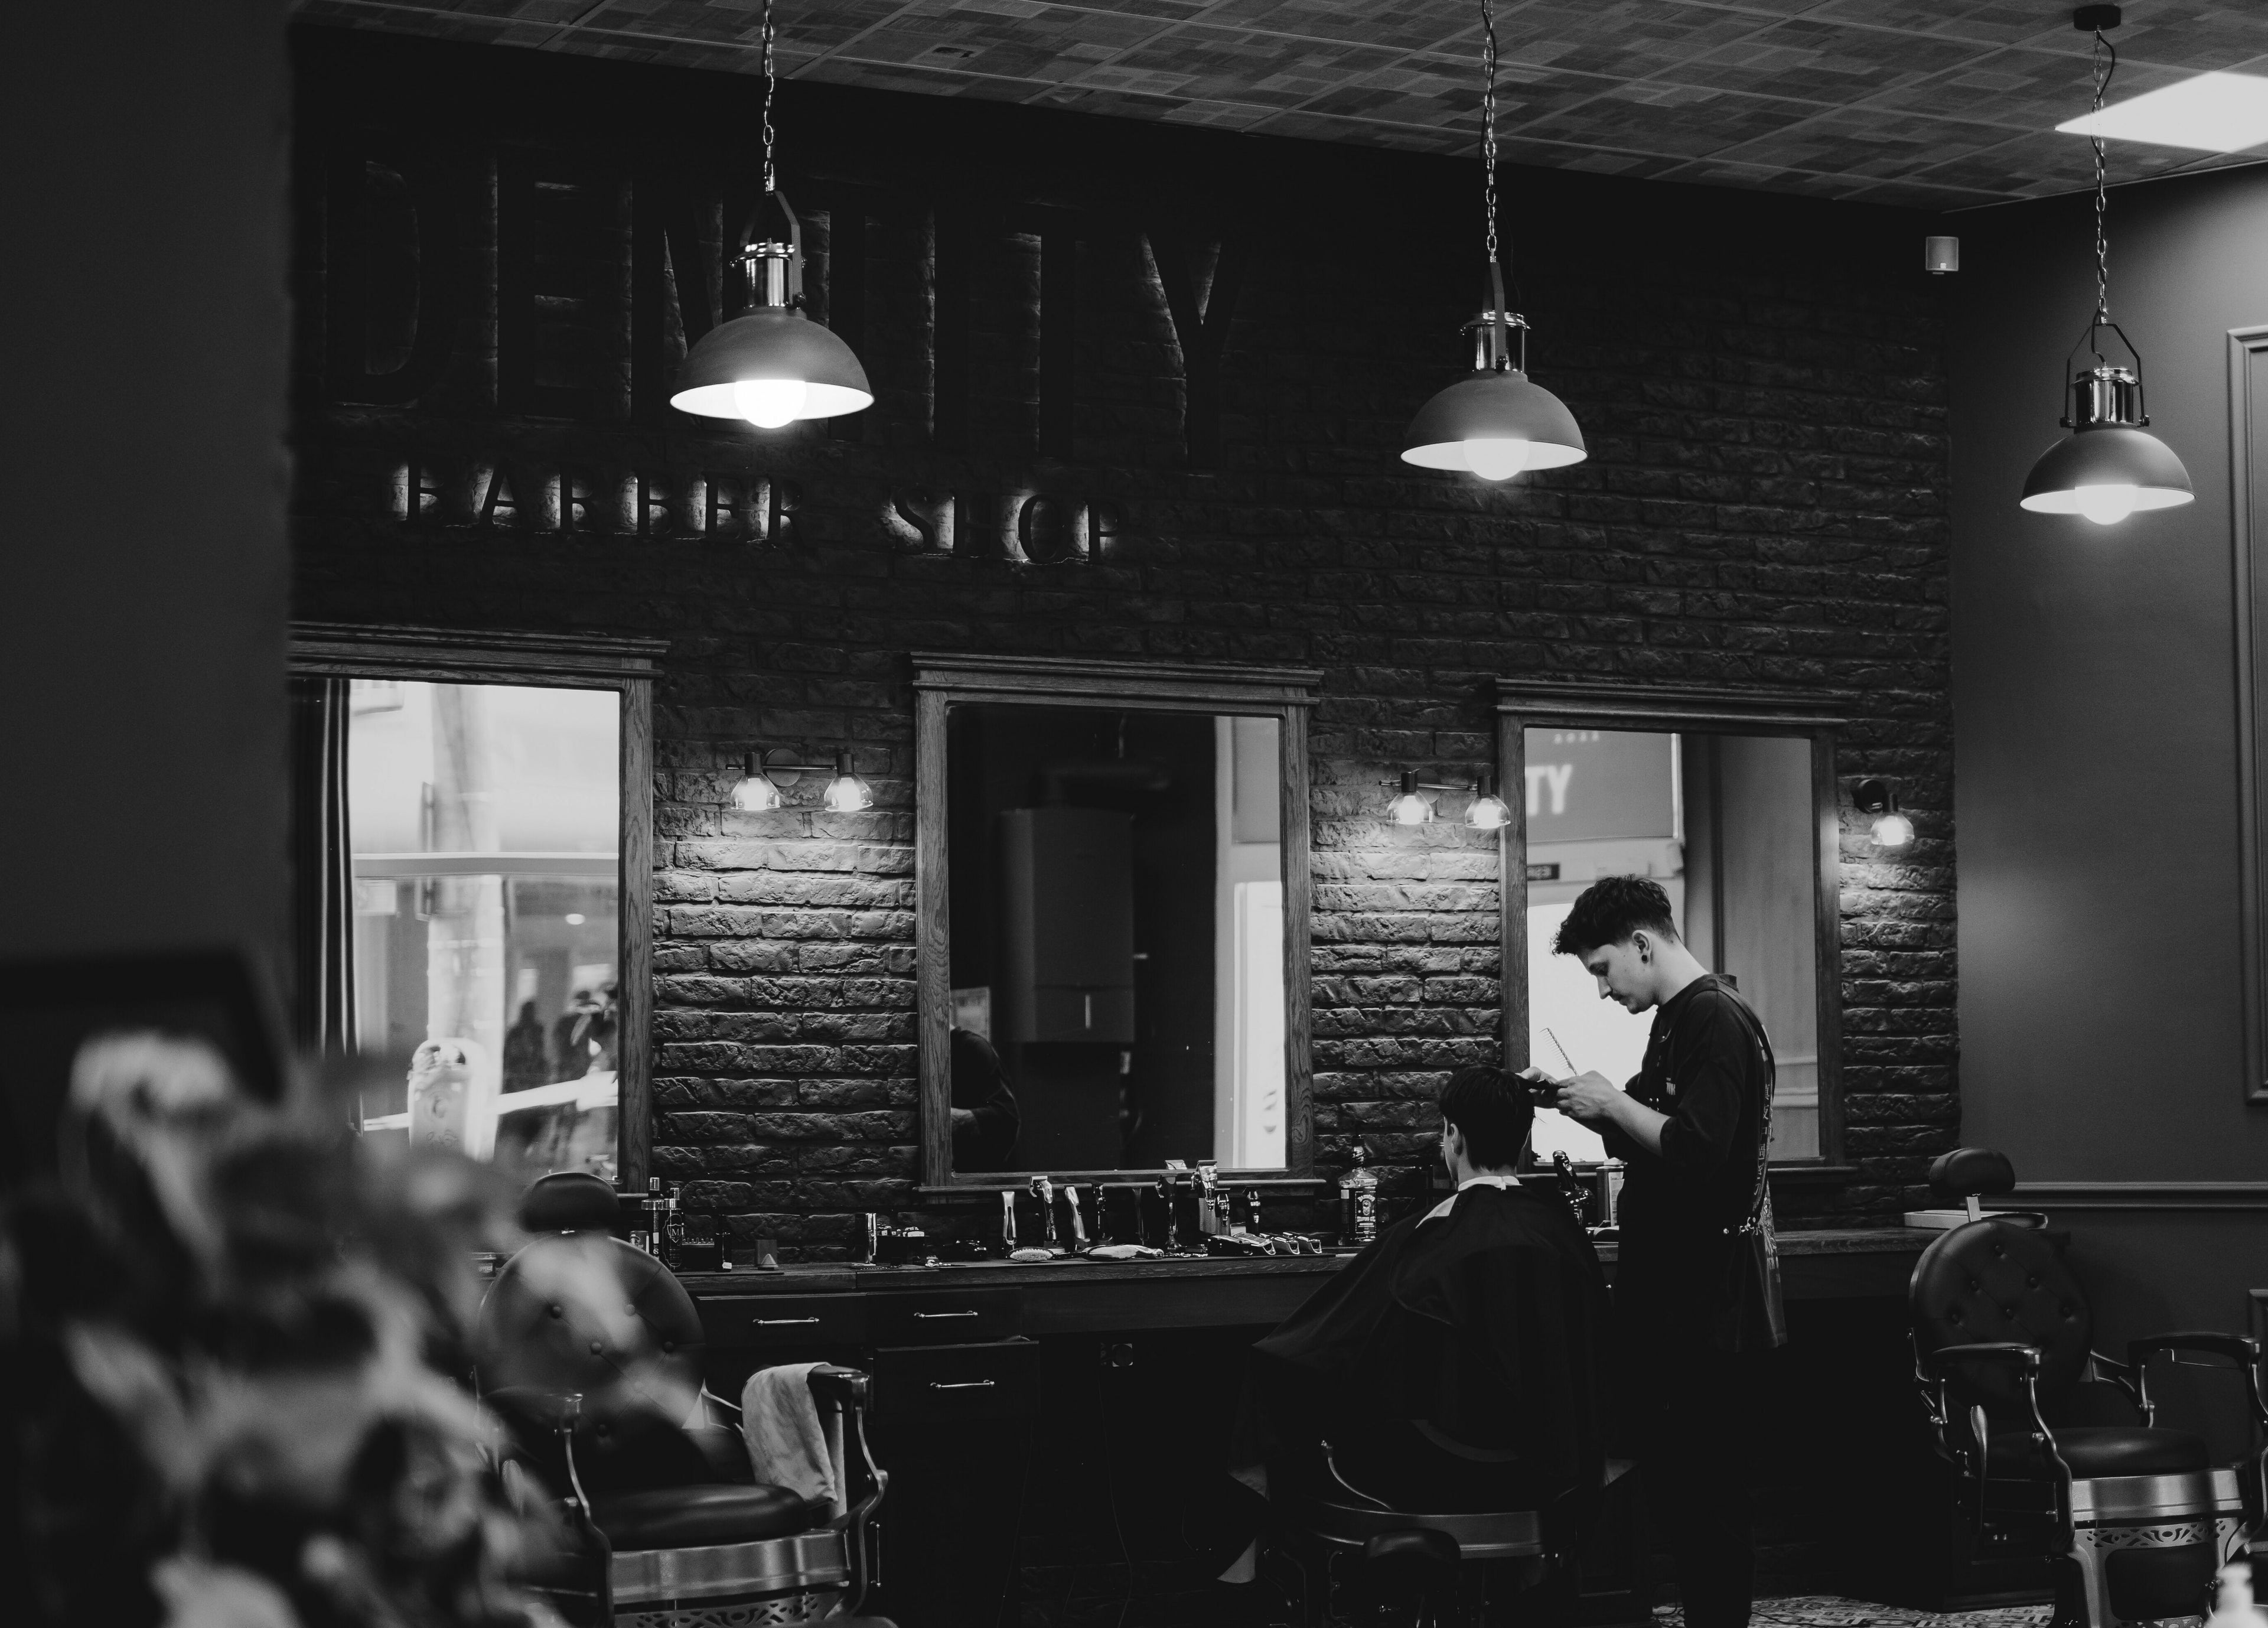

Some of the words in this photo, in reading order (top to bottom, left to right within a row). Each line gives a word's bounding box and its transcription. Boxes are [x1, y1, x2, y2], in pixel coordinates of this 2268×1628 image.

[399, 458, 808, 549] BARBER
[891, 484, 1123, 566] SHOP
[672, 1228, 679, 1236] M
